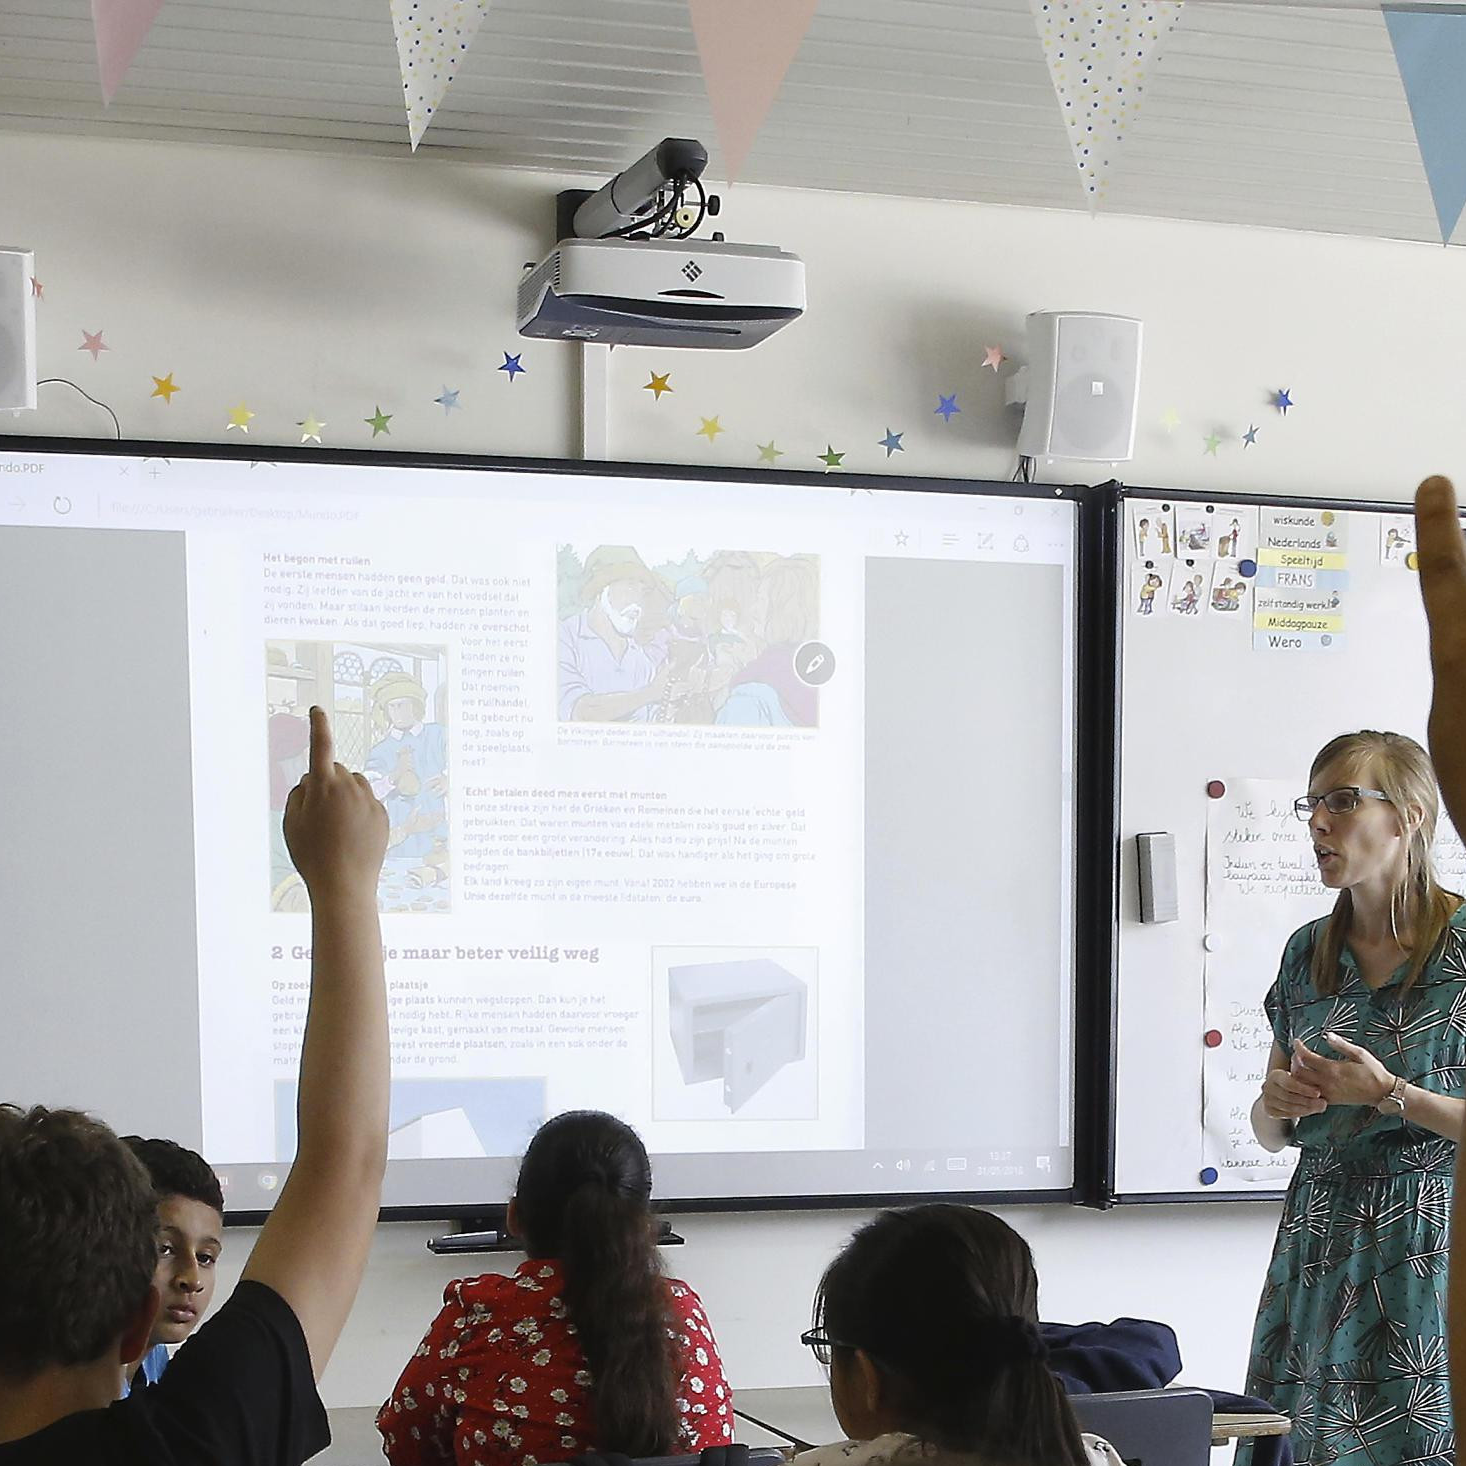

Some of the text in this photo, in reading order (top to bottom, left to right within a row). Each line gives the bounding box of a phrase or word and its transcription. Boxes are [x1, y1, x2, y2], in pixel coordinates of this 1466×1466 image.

[1273, 515, 1315, 527] wiskunde
[1268, 537, 1321, 549] Nederlands
[1280, 554, 1323, 569] Speeltijd
[1277, 572, 1313, 587] FRANS
[1268, 618, 1328, 631] Middagpauze
[1268, 635, 1302, 648] Wero
[271, 946, 283, 960] 2
[403, 948, 451, 960] maar
[456, 946, 504, 960] beter
[508, 945, 560, 963] veilig
[563, 949, 599, 963] weg
